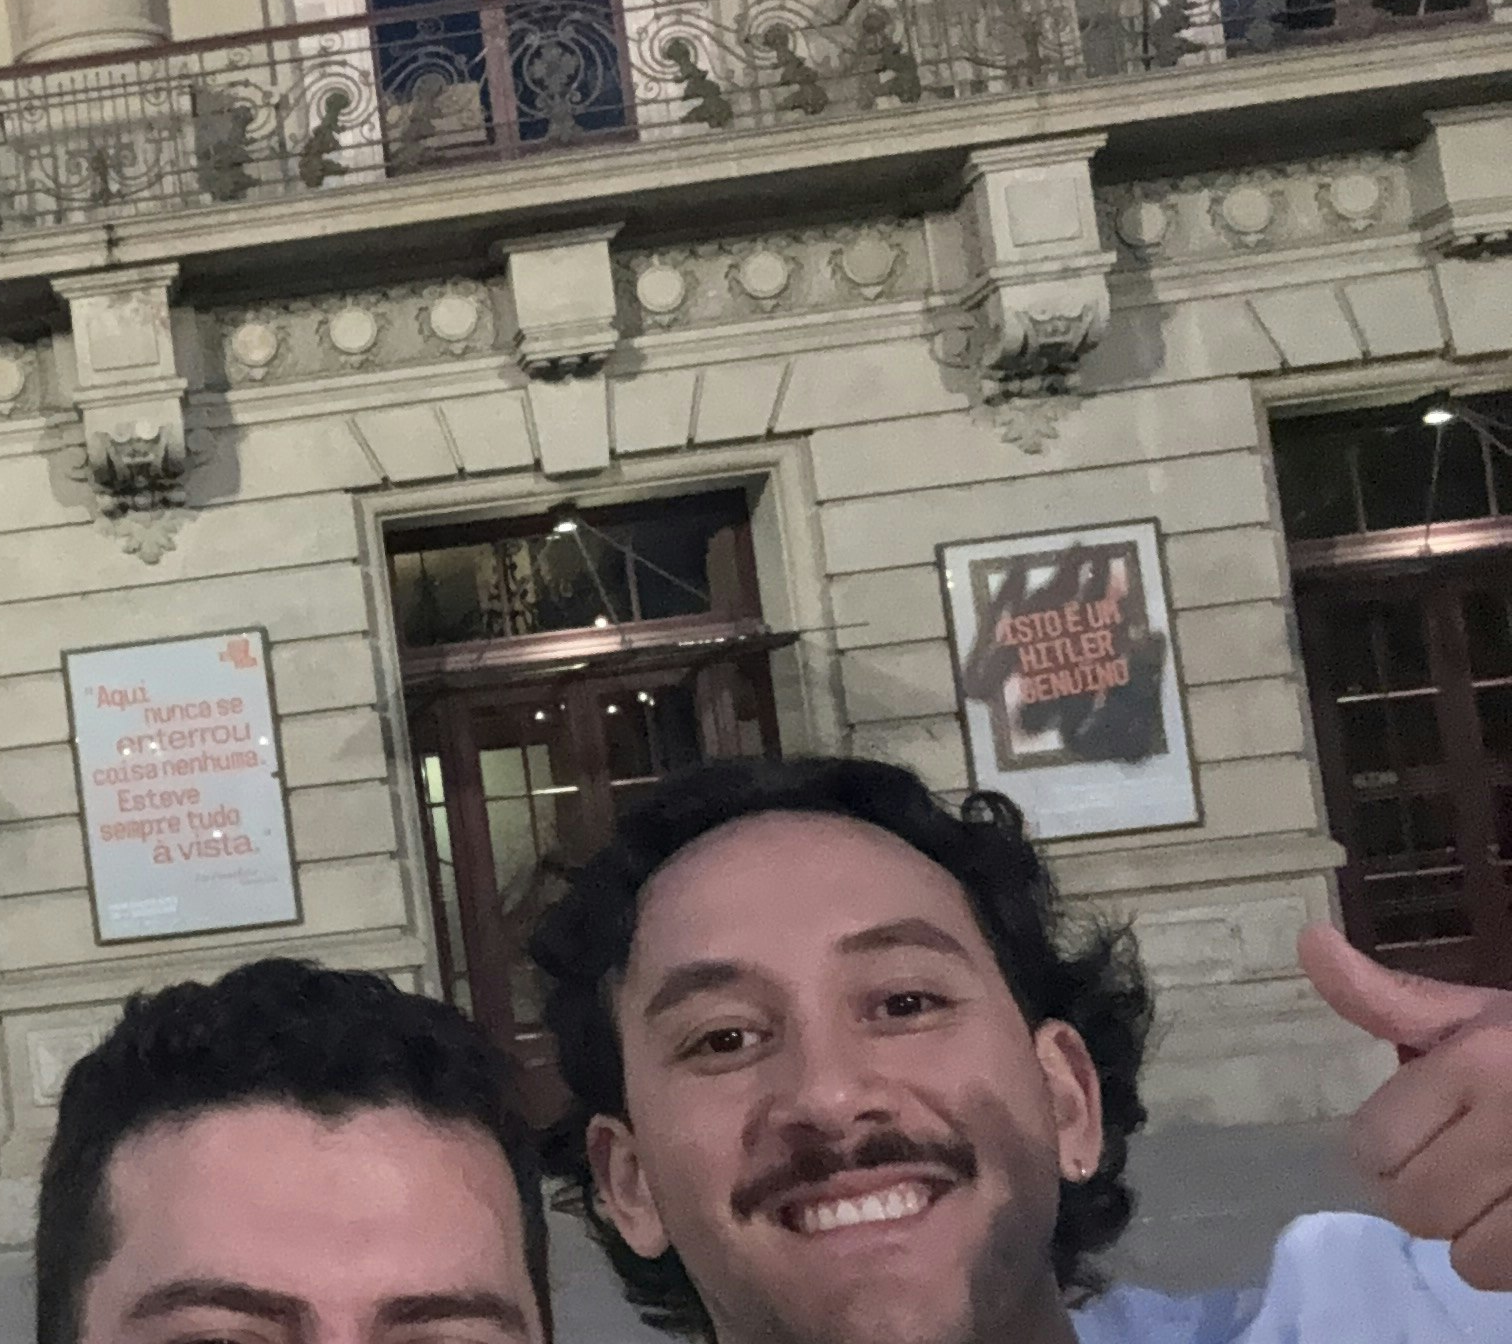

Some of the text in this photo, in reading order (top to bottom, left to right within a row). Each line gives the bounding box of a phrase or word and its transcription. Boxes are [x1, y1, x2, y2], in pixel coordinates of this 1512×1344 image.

[996, 610, 1063, 645] ISTO
[1087, 600, 1122, 628] UM
[1019, 629, 1116, 673] HITLER
[144, 697, 243, 724] nunca se
[116, 722, 251, 755] enterrou
[93, 759, 158, 786] coisa
[100, 803, 241, 843] sempre tudo
